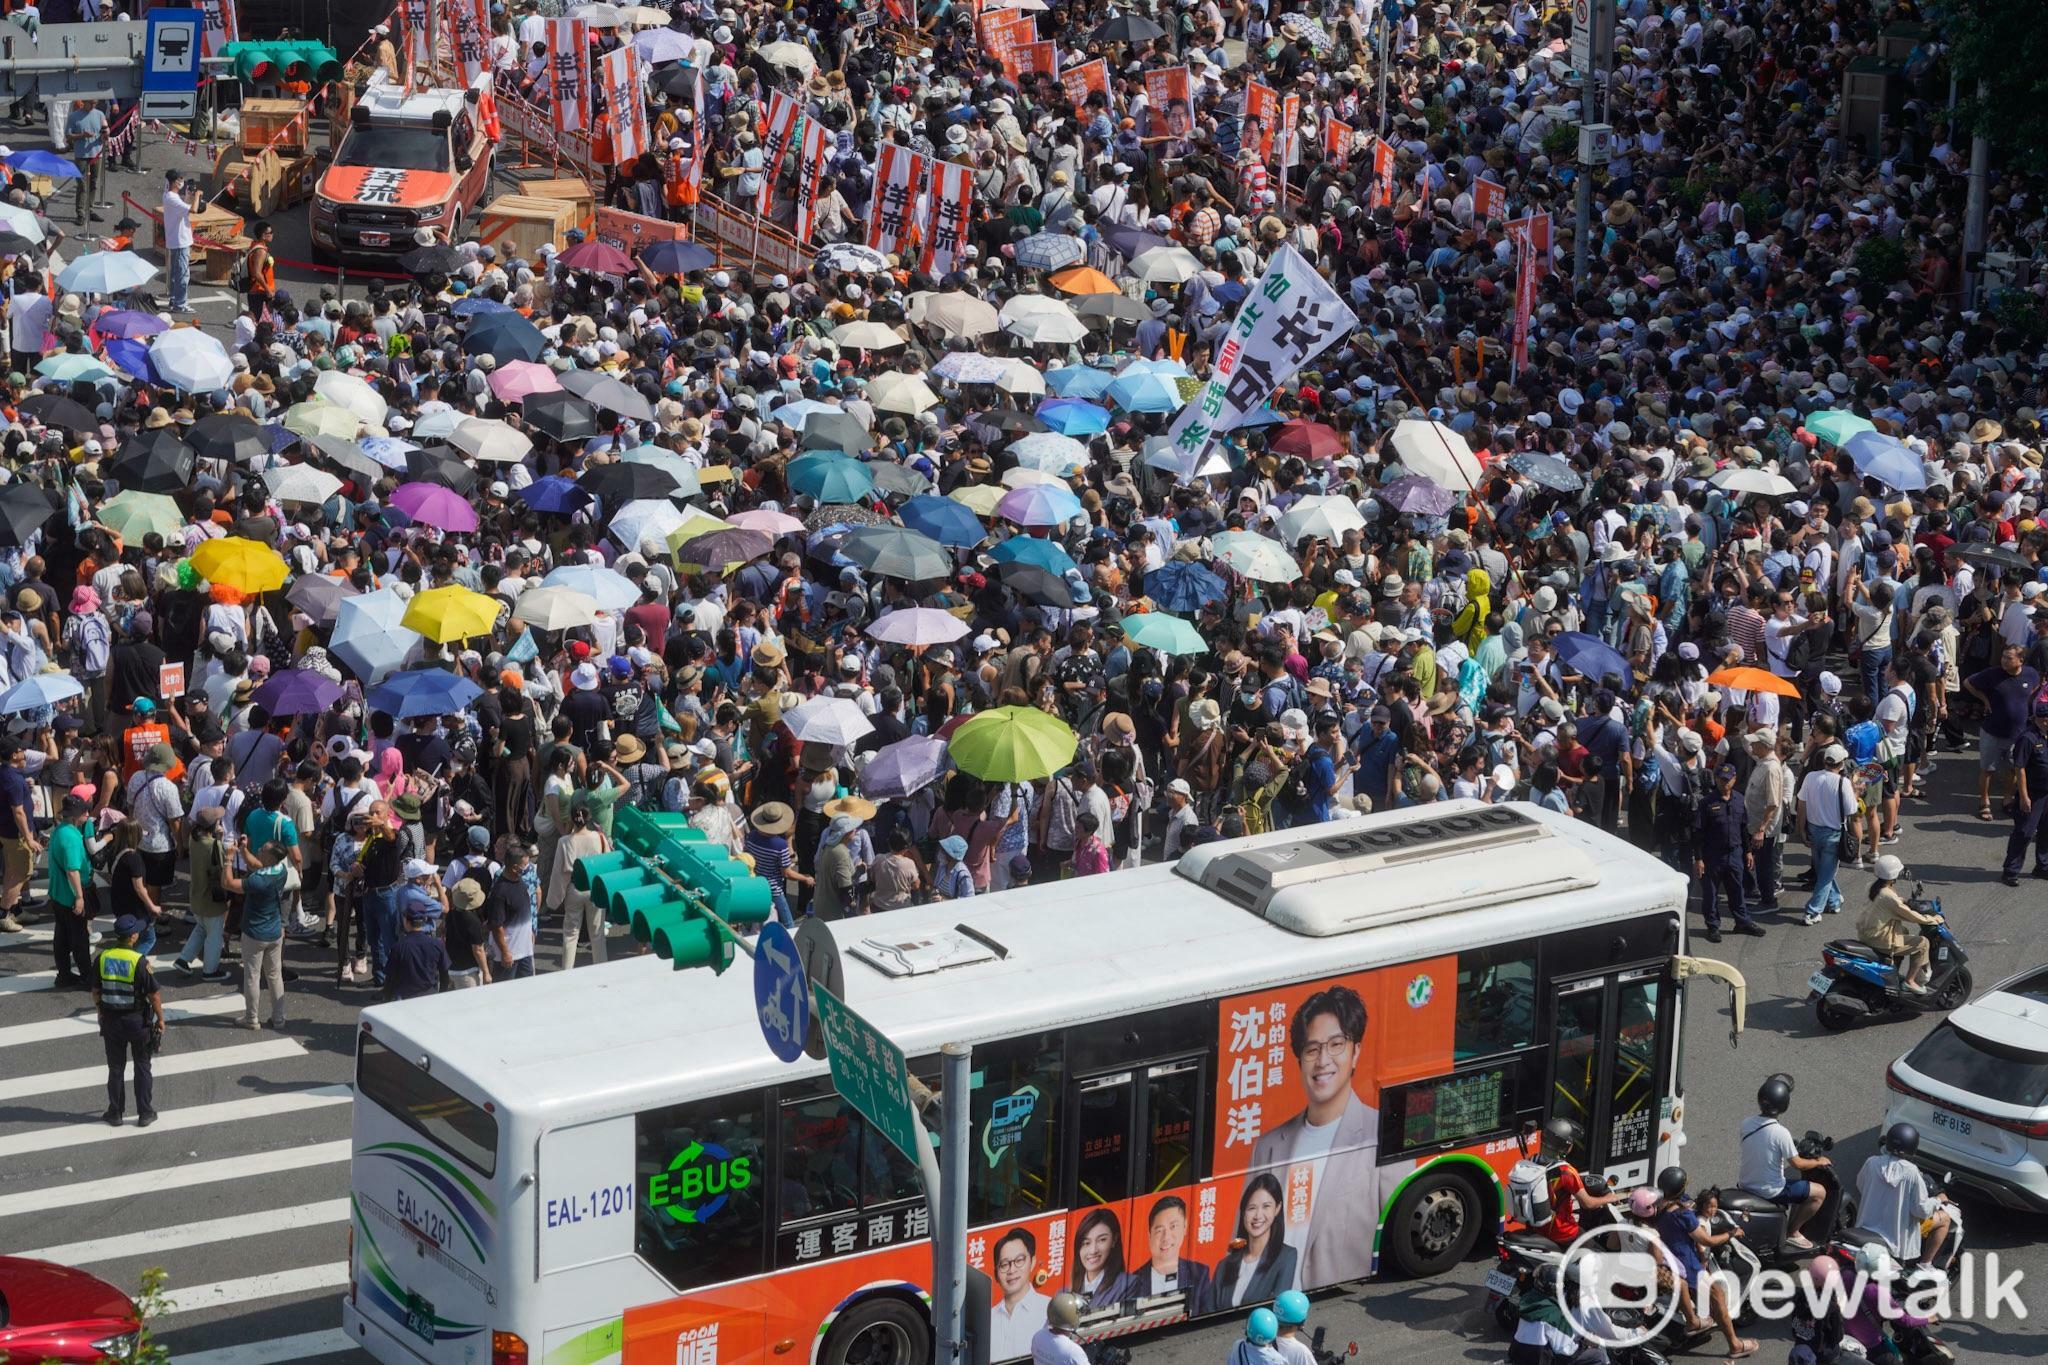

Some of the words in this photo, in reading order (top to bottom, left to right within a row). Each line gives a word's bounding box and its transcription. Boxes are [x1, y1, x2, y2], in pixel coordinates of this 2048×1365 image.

[353, 171, 409, 203] 洋流
[877, 181, 911, 238] 洋流
[934, 195, 964, 253] 洋流
[825, 1000, 898, 1081] 北平東路
[830, 1031, 869, 1080] BeiPing
[1266, 1002, 1286, 1088] 你的市長
[1224, 1006, 1266, 1149] 沈伯洋
[1485, 1132, 1537, 1155] 台北順來
[547, 1183, 633, 1229] EAL-1201
[650, 1156, 751, 1208] E-BUS
[1290, 1168, 1310, 1225] 林亮君
[397, 1188, 454, 1250] EAL-1201
[1197, 1187, 1217, 1244] 賴俊翰
[1047, 1219, 1067, 1279] 顏若芳
[677, 1322, 720, 1344] SOON
